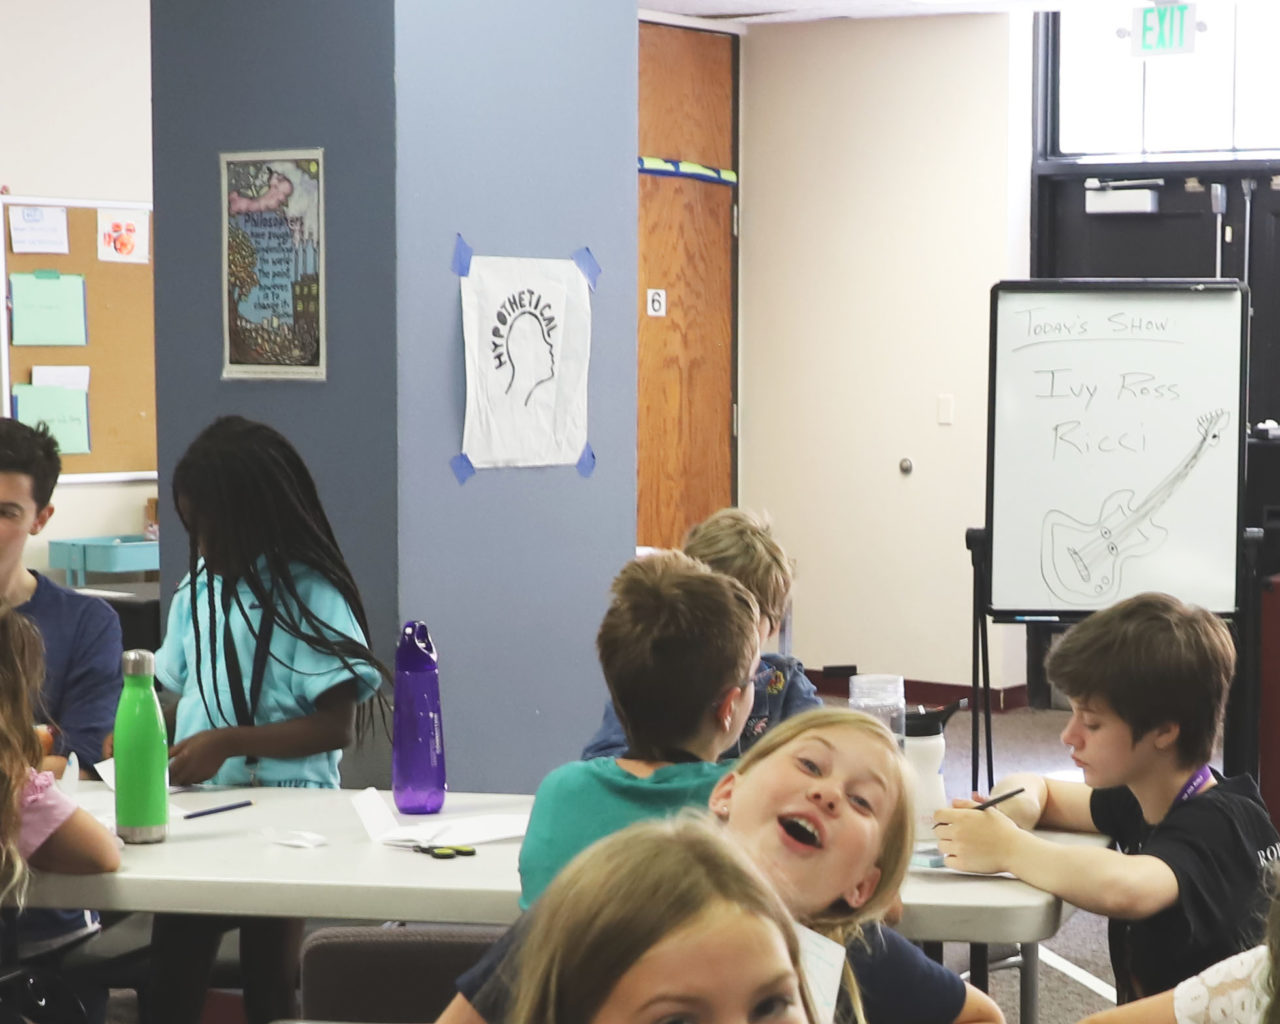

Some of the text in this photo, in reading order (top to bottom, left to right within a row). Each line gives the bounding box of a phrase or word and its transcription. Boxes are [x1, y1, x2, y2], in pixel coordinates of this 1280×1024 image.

[1142, 5, 1188, 50] EXIT
[651, 292, 661, 312] 6
[492, 288, 557, 370] HYPOTHETICAL
[1107, 312, 1169, 334] SHOW
